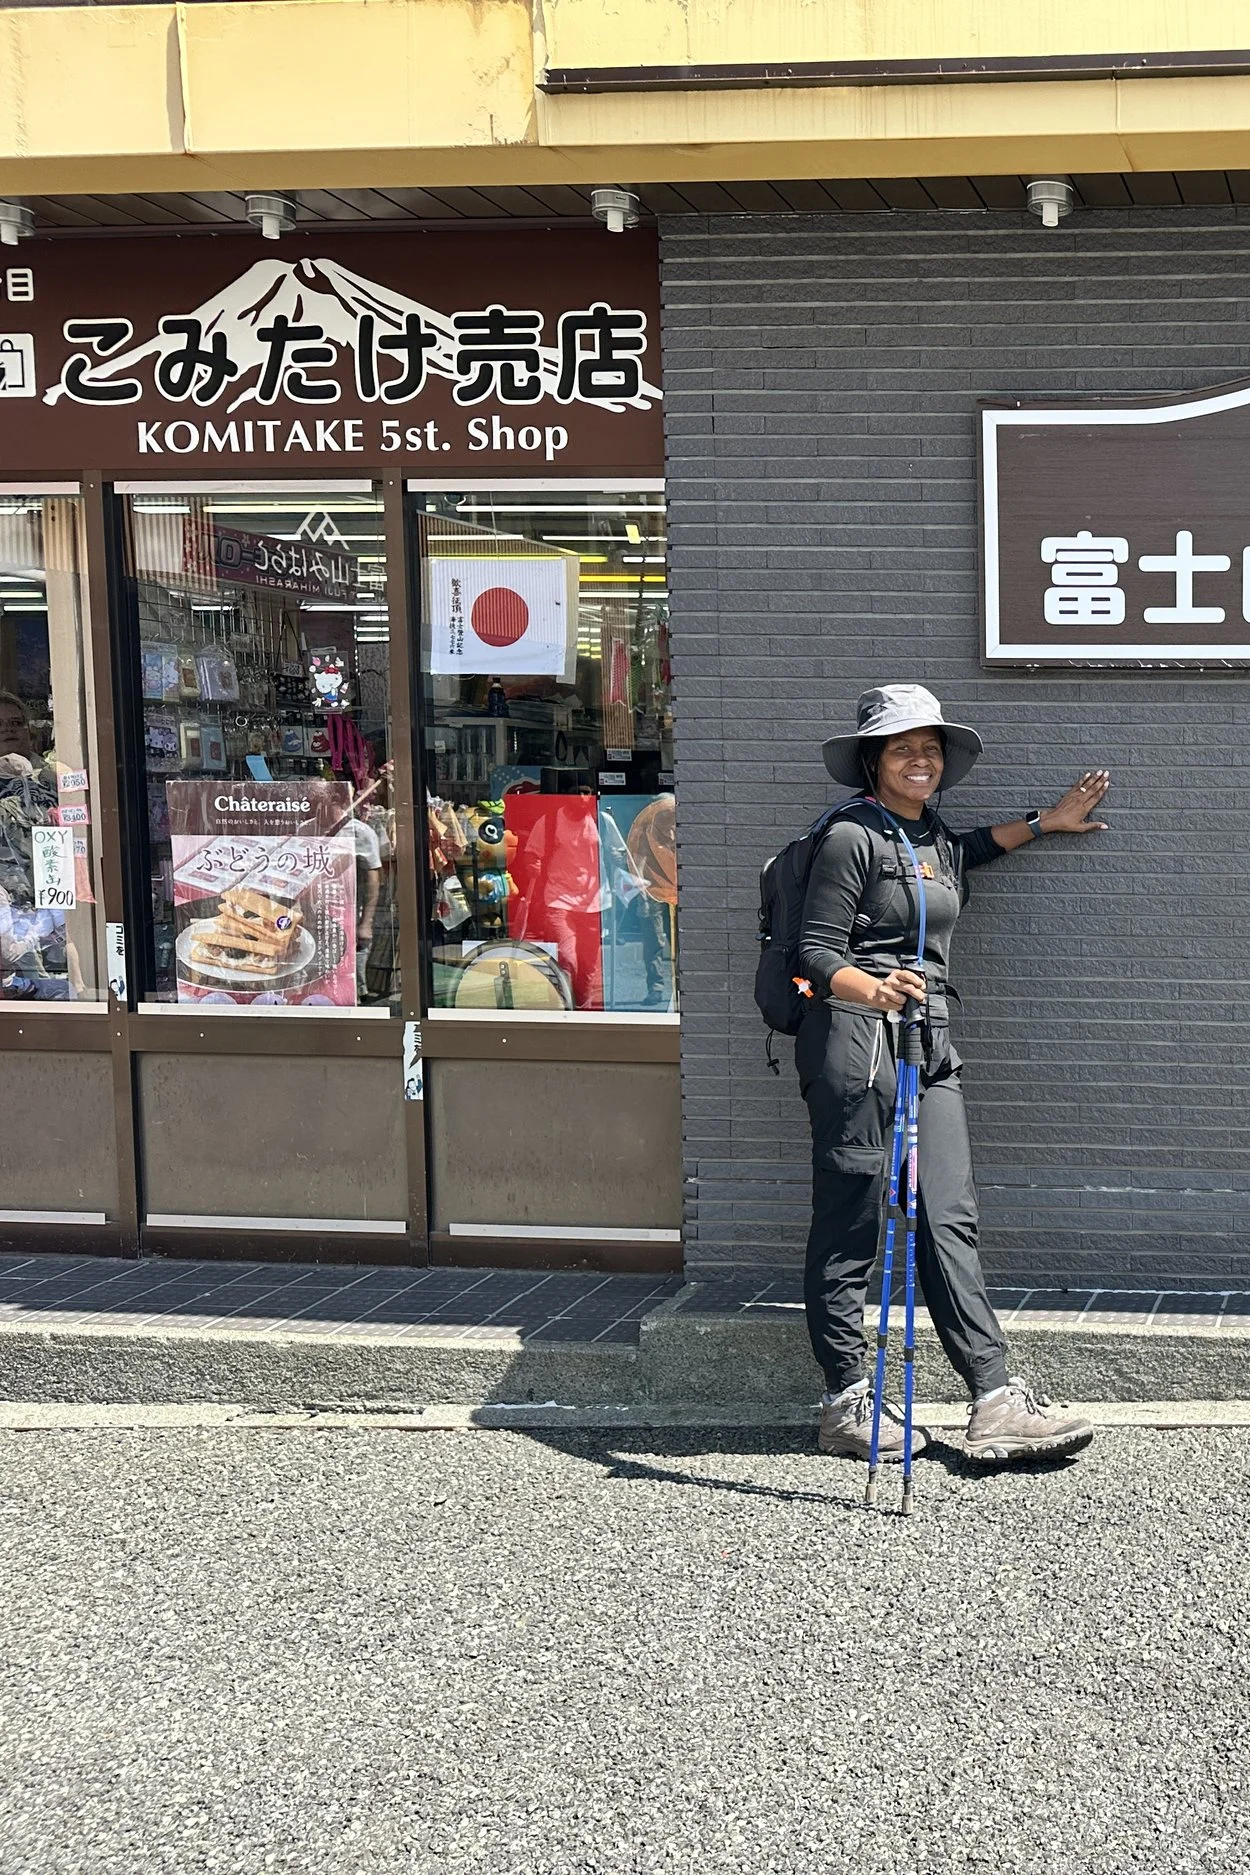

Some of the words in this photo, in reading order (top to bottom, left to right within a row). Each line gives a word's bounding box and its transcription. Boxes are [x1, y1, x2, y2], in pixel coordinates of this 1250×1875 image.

[0, 268, 35, 302] 目
[61, 302, 648, 406] こみたけ売店
[136, 419, 365, 454] KOMITAKE
[379, 419, 452, 452] 5st.
[466, 415, 569, 461] Shop
[214, 795, 311, 813] Châteraisé
[34, 830, 68, 844] OXY
[196, 845, 335, 877] ぶどうの城
